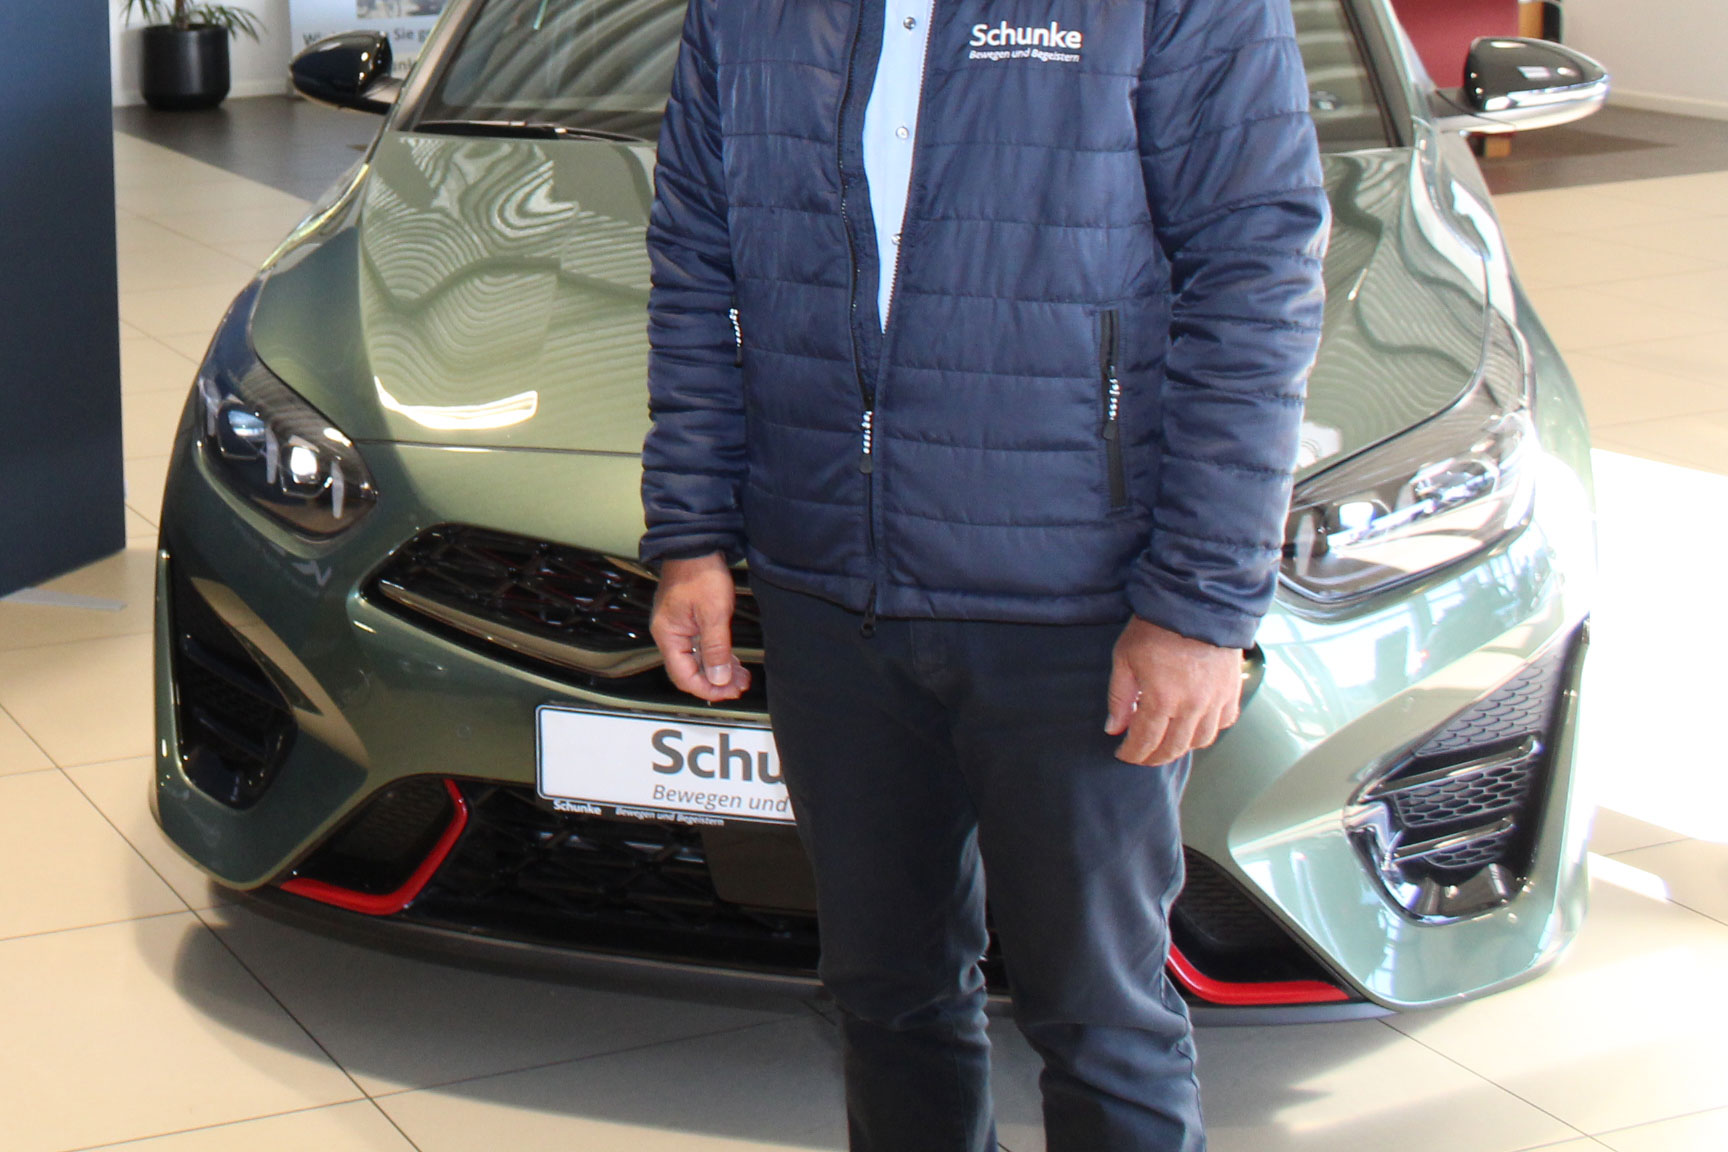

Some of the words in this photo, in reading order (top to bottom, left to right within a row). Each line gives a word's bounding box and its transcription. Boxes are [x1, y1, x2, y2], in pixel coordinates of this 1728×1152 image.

[969, 21, 1083, 49] Schunke
[969, 50, 1010, 62] Bewegen
[1011, 48, 1031, 59] und
[1031, 49, 1080, 63] Begeistern
[651, 728, 786, 785] Schu
[652, 784, 743, 810] Bewegen
[748, 796, 788, 813] und
[552, 799, 603, 816] Schunke
[615, 806, 655, 821] Bewegen
[656, 812, 676, 822] und
[676, 813, 725, 827] Begeistern
